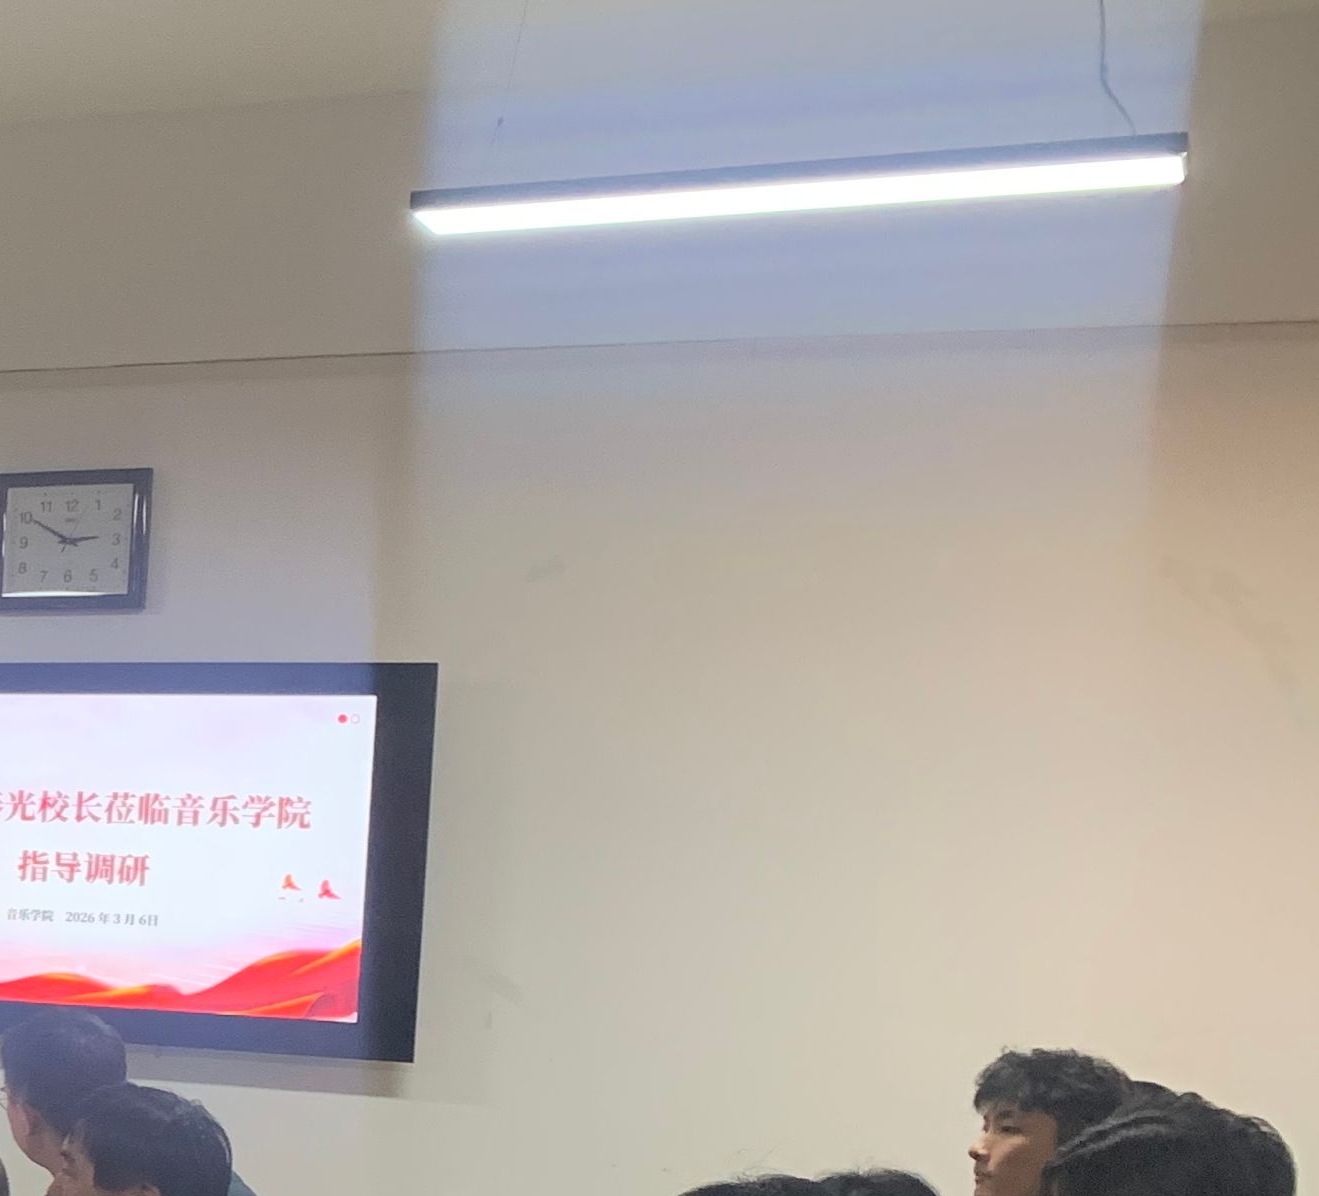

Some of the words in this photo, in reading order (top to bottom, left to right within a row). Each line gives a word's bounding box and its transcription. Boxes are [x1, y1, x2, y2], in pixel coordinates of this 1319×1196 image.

[40, 501, 52, 512] 11
[65, 499, 78, 512] 12
[96, 500, 101, 511] 1
[20, 512, 32, 524] 10
[113, 509, 122, 520] 2
[19, 536, 28, 549] 9
[112, 533, 121, 545] 3
[18, 562, 27, 574] 8
[110, 558, 119, 569] 4
[40, 571, 48, 582] 7
[63, 570, 72, 582] 6
[89, 569, 98, 582] 5
[17, 849, 150, 887] 指导调研
[7, 907, 54, 922] 音乐学院
